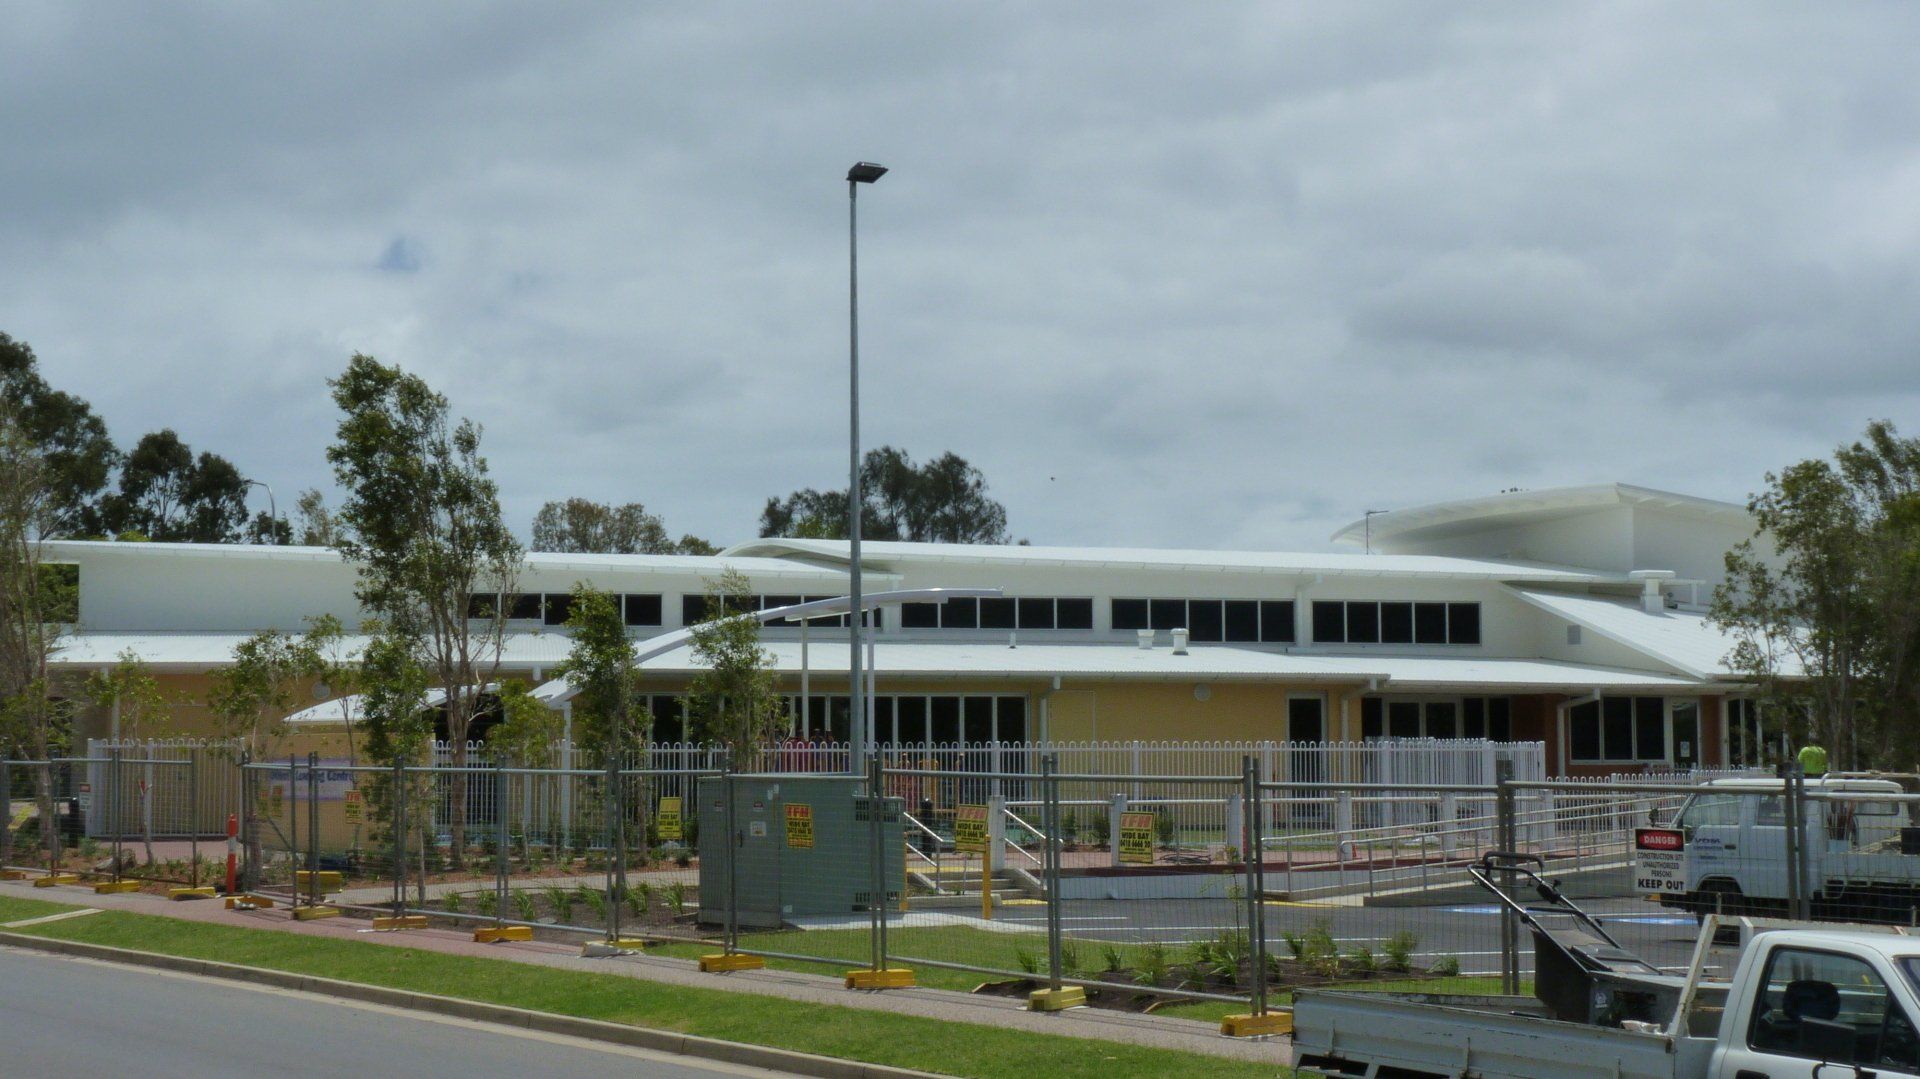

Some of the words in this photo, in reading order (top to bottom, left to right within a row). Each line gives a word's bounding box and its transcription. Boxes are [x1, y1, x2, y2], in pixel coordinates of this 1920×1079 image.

[1137, 832, 1149, 840] BAY
[1644, 835, 1676, 844] DANGER
[1637, 852, 1674, 860] CONSTRUCTION
[1652, 870, 1672, 878] PERSONS
[1638, 878, 1662, 888] KEEP
[1666, 880, 1684, 890] OUT
